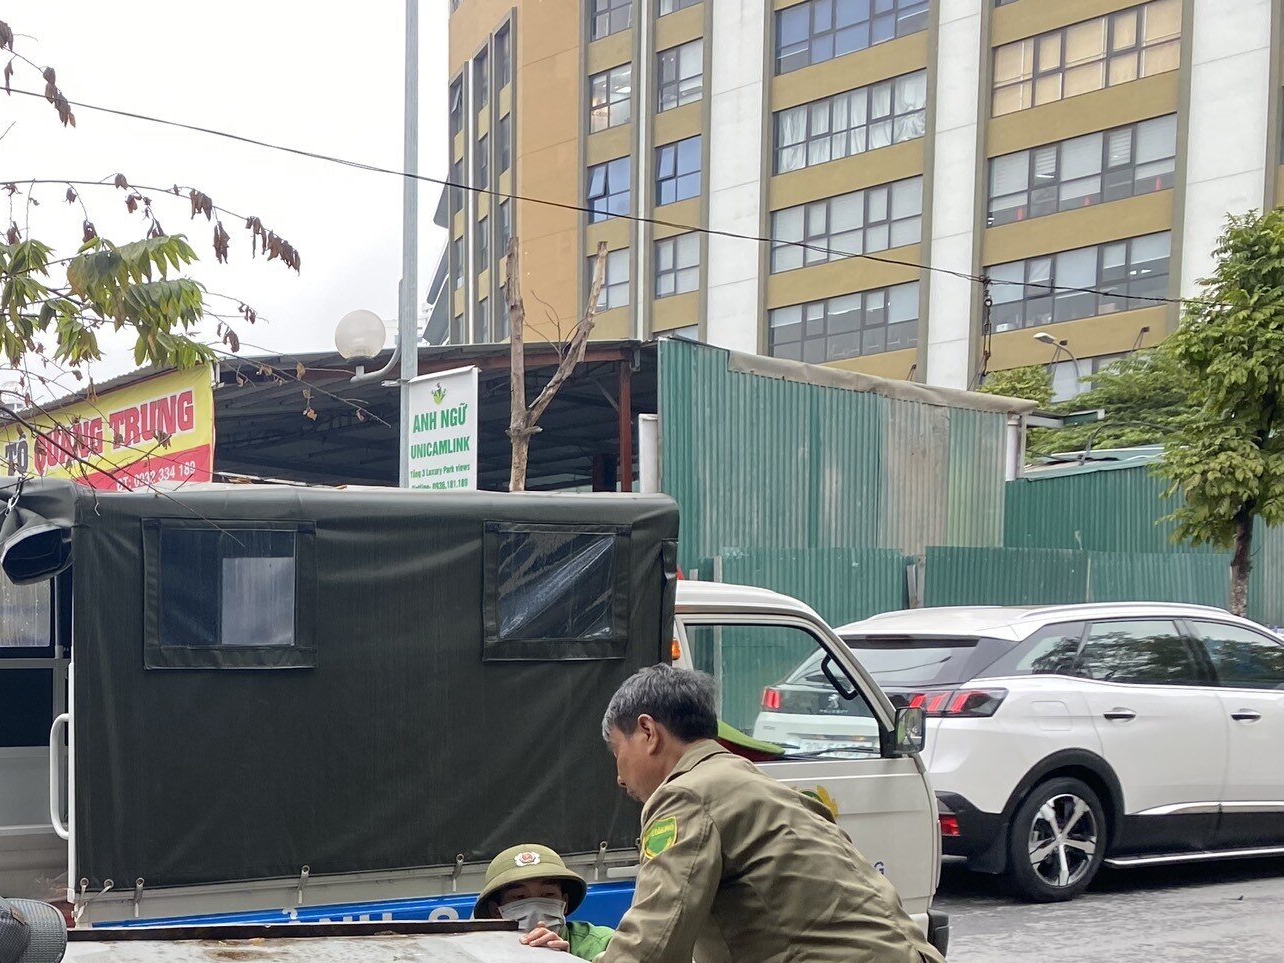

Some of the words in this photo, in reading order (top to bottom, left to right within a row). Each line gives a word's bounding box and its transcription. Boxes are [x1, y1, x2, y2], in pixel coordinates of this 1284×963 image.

[110, 390, 194, 450] TRUNG
[413, 412, 437, 433] ANH
[441, 403, 468, 428] NGỮ
[411, 436, 470, 459] UNICAMLINK
[158, 464, 176, 481] 334
